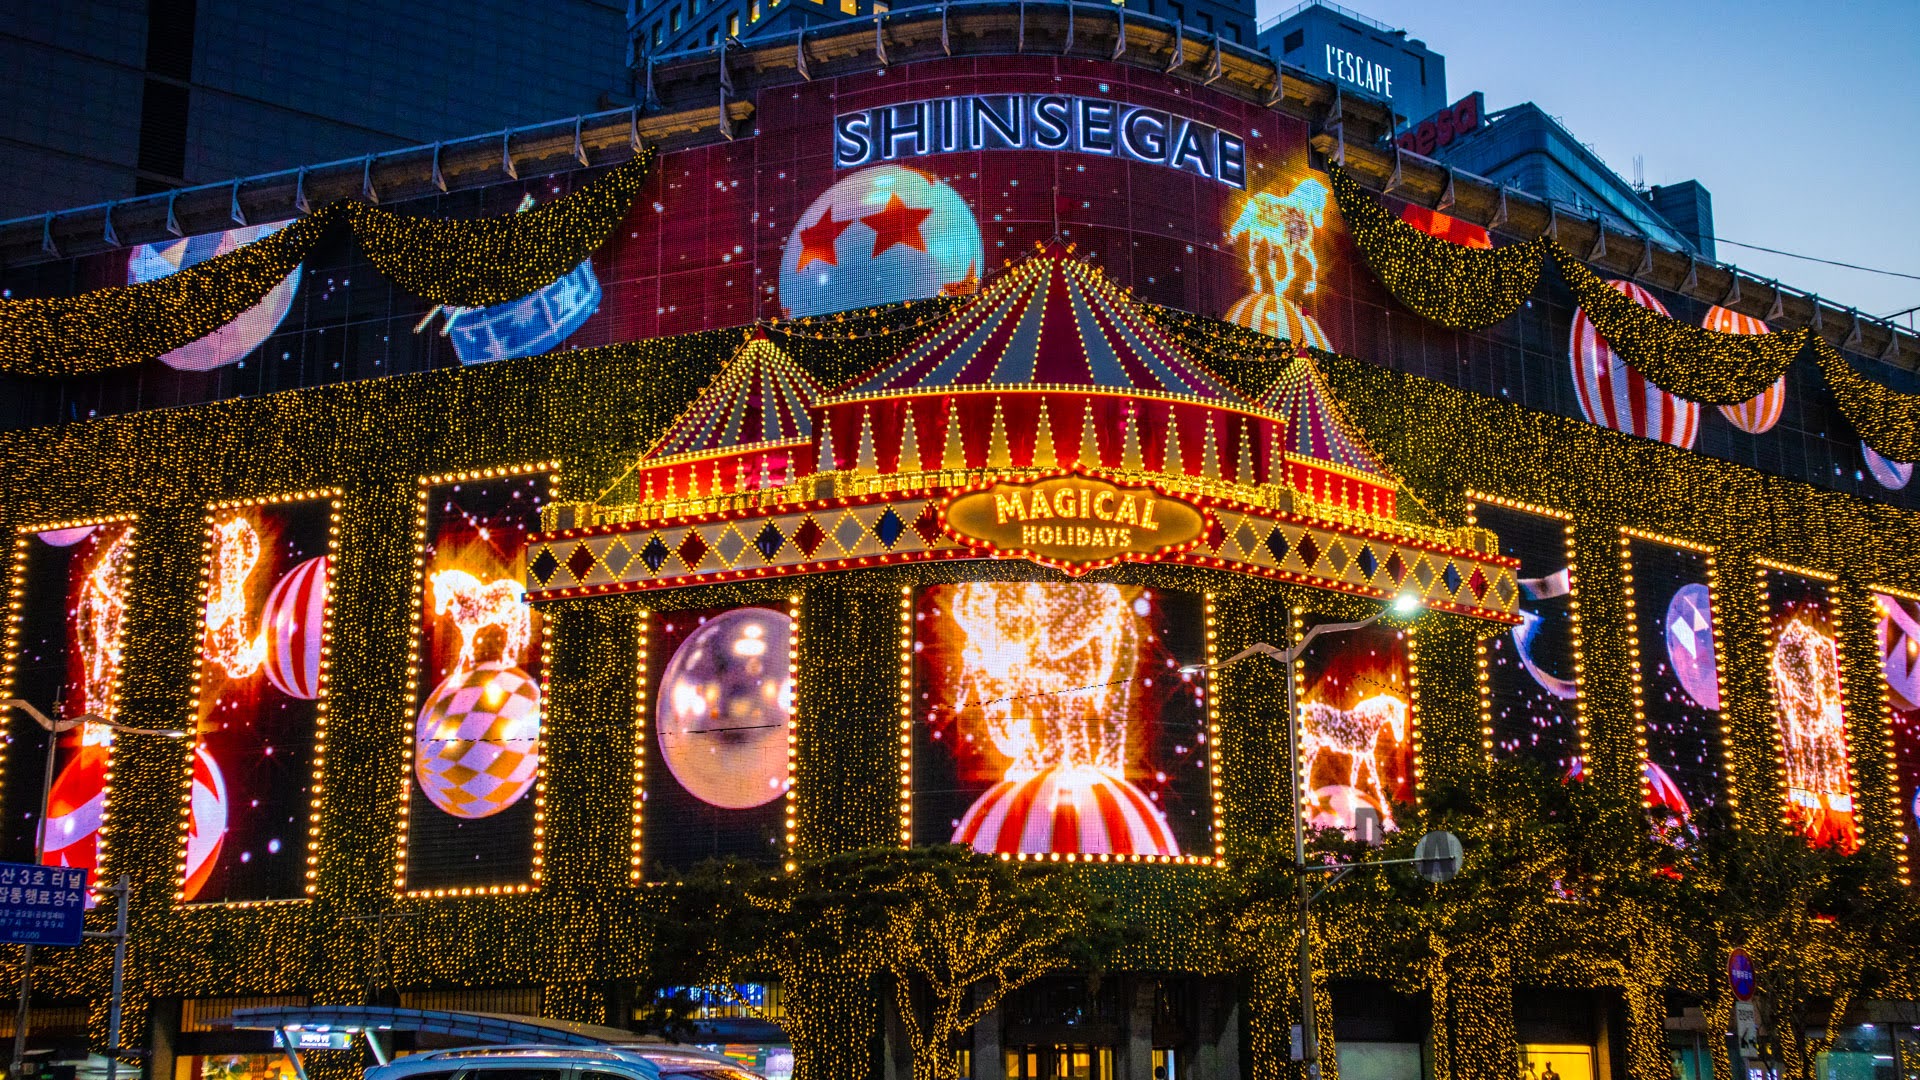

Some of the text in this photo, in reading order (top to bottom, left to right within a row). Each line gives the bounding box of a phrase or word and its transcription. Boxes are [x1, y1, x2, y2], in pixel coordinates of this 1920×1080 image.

[1326, 43, 1393, 98] L'ESCAPE
[837, 94, 1244, 187] SHINSEGAE
[993, 488, 1160, 531] MAGICAL
[1022, 525, 1132, 547] HOLIDAYS
